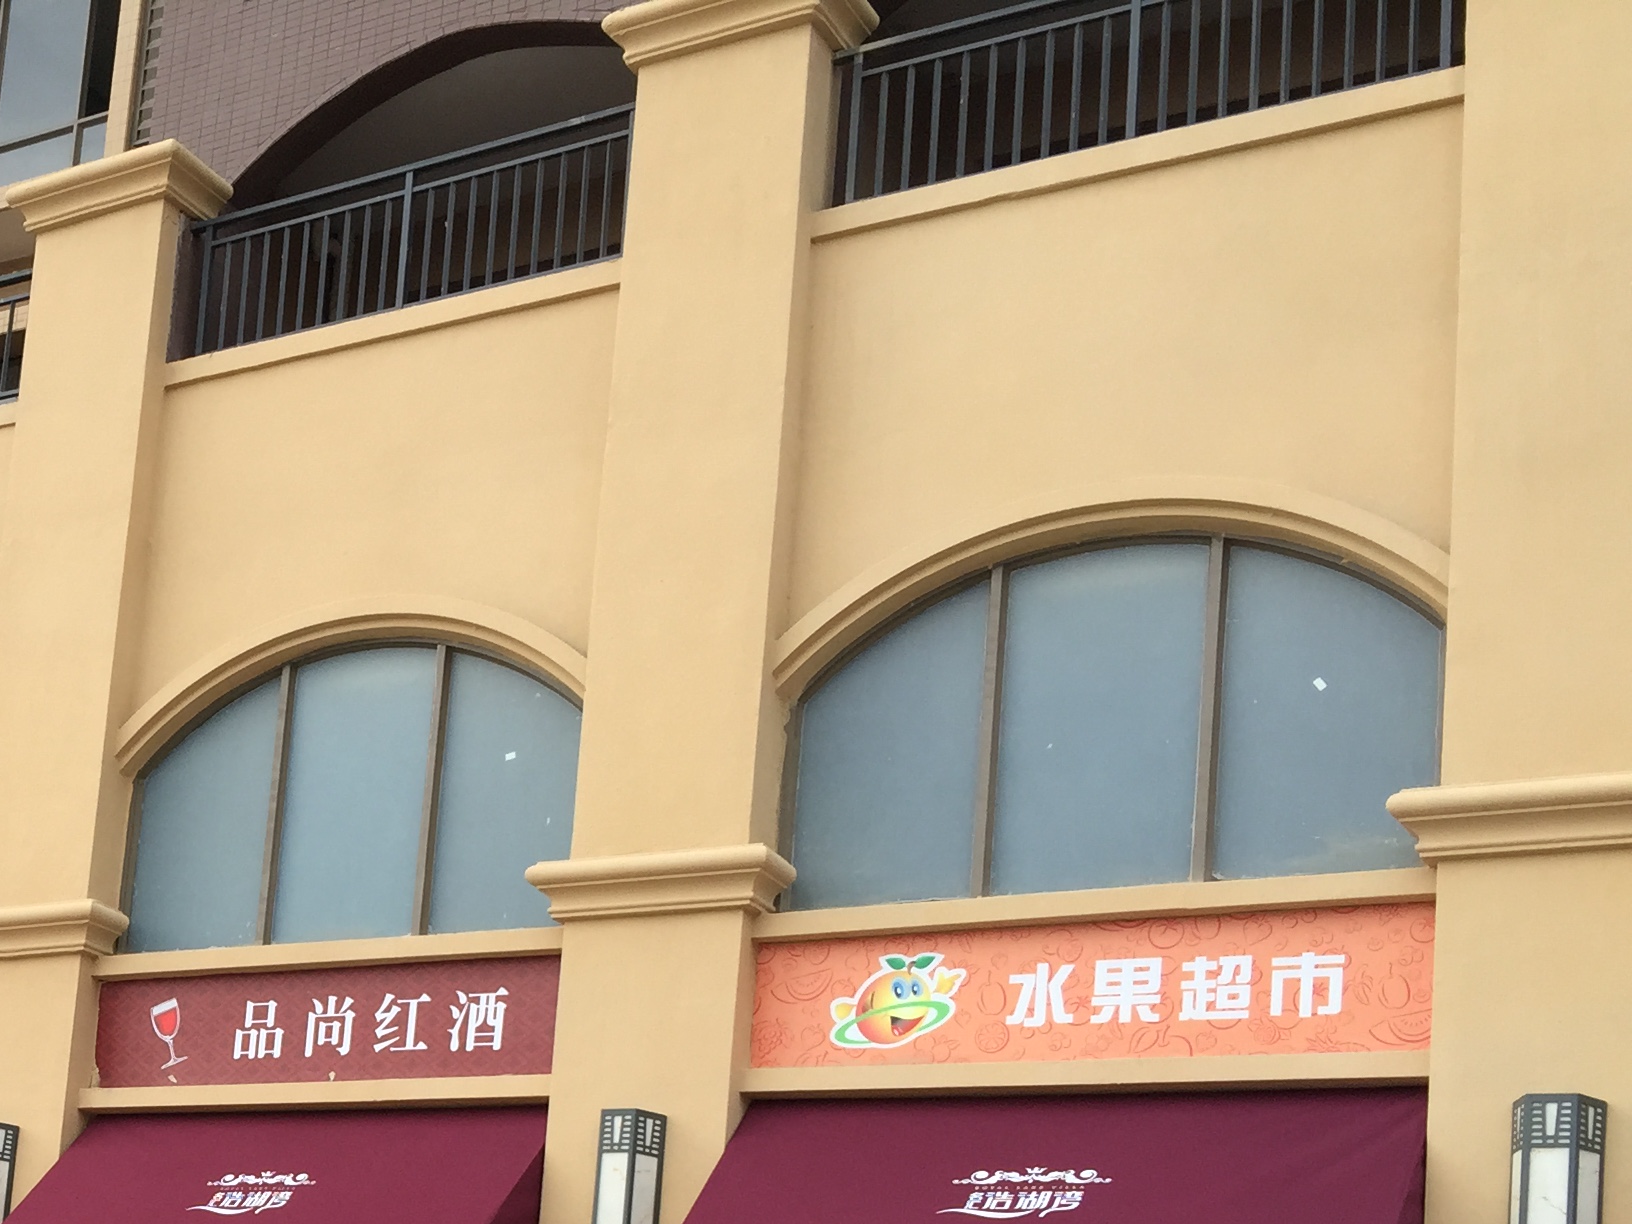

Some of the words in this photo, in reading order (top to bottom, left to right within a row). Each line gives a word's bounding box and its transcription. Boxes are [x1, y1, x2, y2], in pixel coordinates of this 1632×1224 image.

[233, 987, 510, 1061] 品尚红酒
[1005, 951, 1346, 1028] 水果超市
